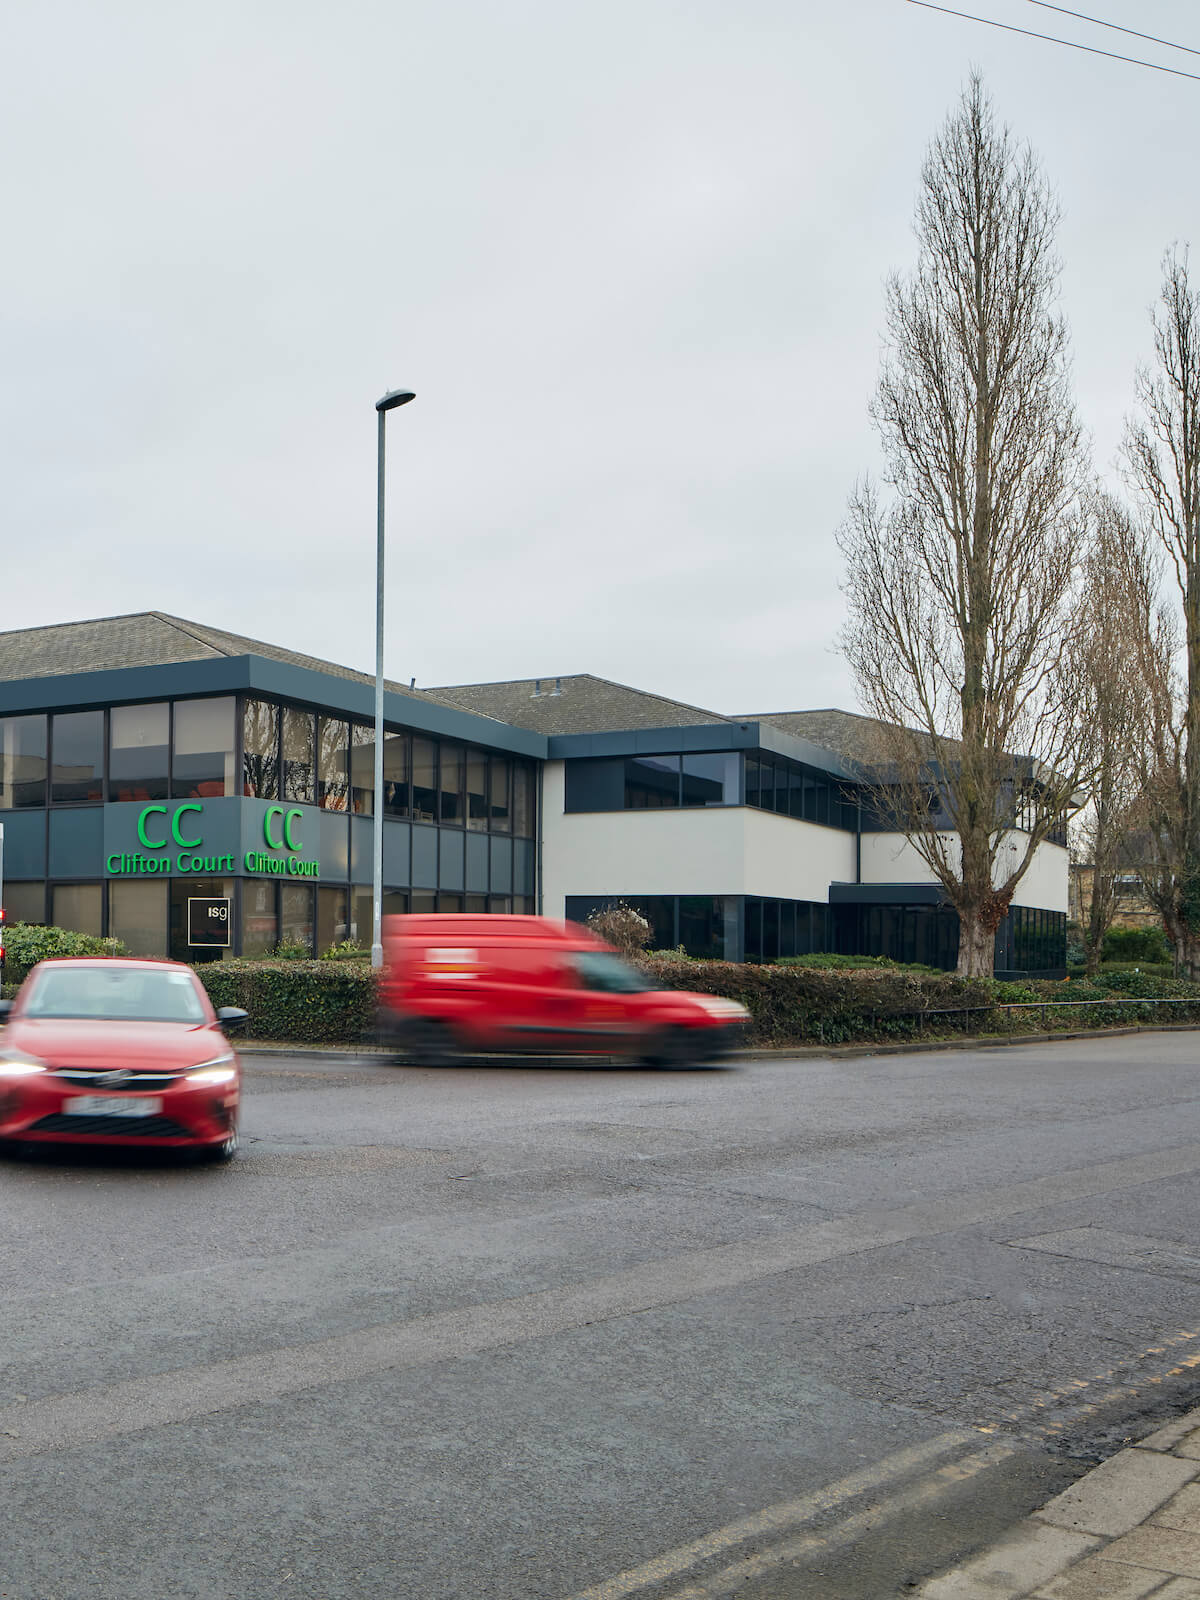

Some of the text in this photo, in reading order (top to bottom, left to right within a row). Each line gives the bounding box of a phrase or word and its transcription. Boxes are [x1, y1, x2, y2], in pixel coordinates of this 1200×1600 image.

[137, 804, 202, 849] CC
[264, 806, 303, 851] CC
[107, 852, 234, 873] Clifton Court
[245, 851, 320, 876] Clifton Court
